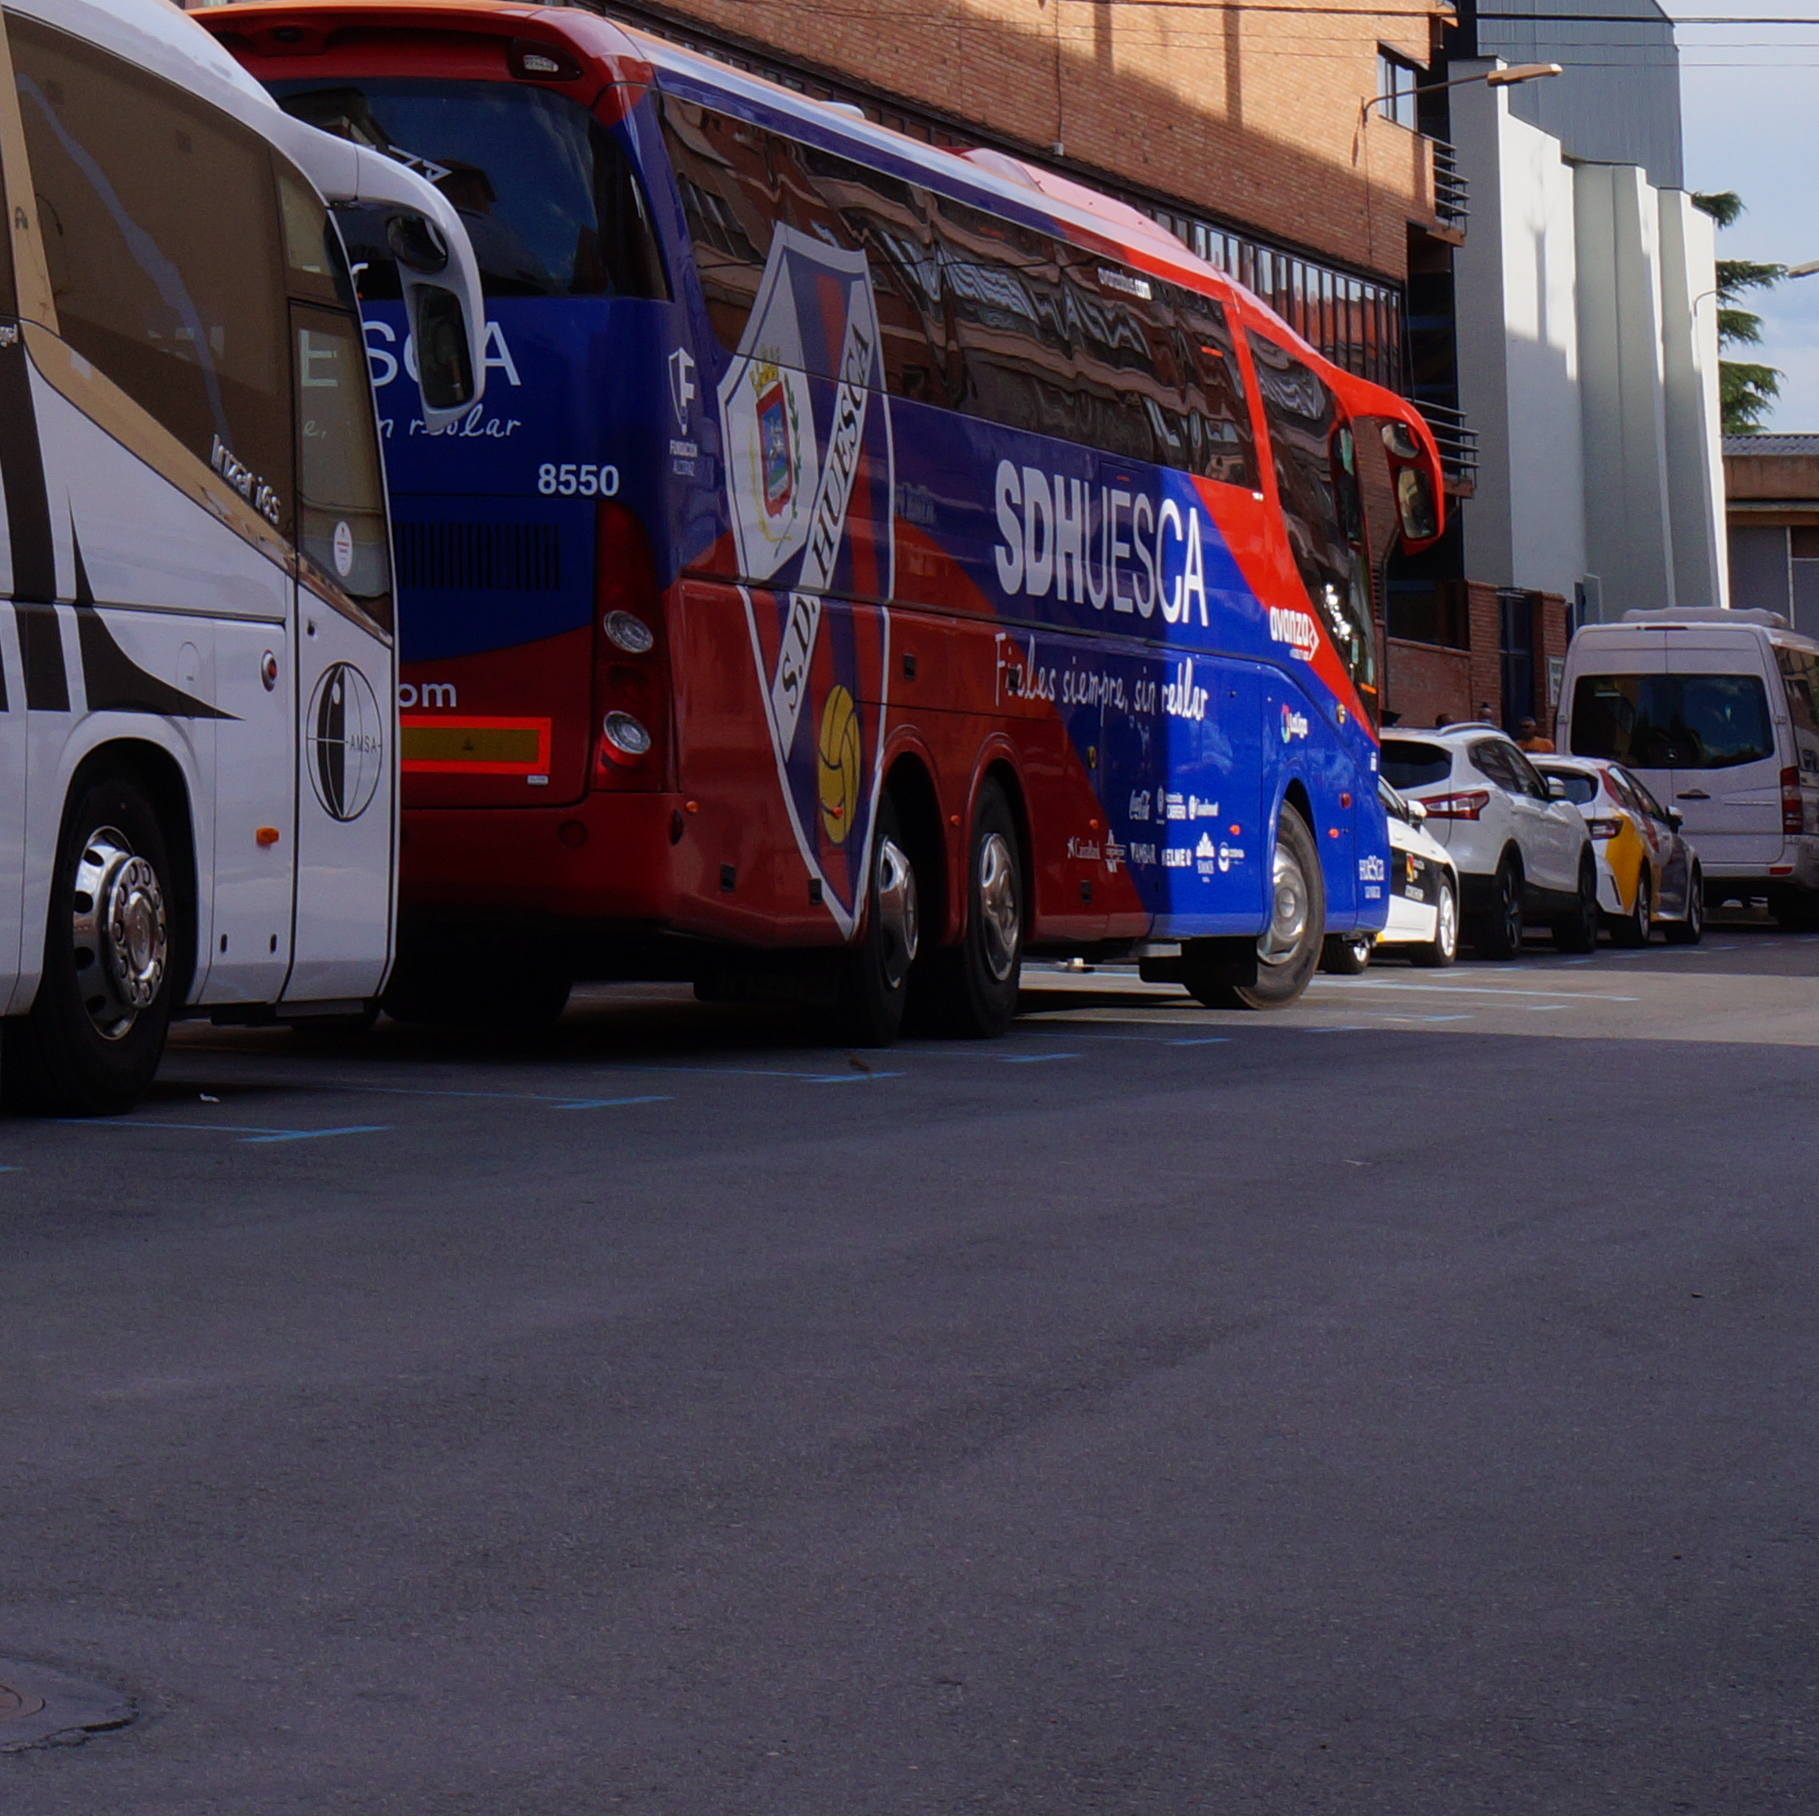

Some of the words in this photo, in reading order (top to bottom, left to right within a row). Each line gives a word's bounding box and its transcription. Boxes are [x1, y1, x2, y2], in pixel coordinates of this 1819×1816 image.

[537, 463, 620, 496] 8550
[810, 323, 871, 580] HUESCA
[994, 459, 1209, 627] SDHUESCA
[780, 594, 817, 716] S.D.
[1269, 605, 1310, 647] avanza
[1063, 656, 1129, 727] siempre,
[1133, 665, 1156, 716] sin
[1162, 657, 1209, 722] reblar
[349, 734, 378, 754] AMSA
